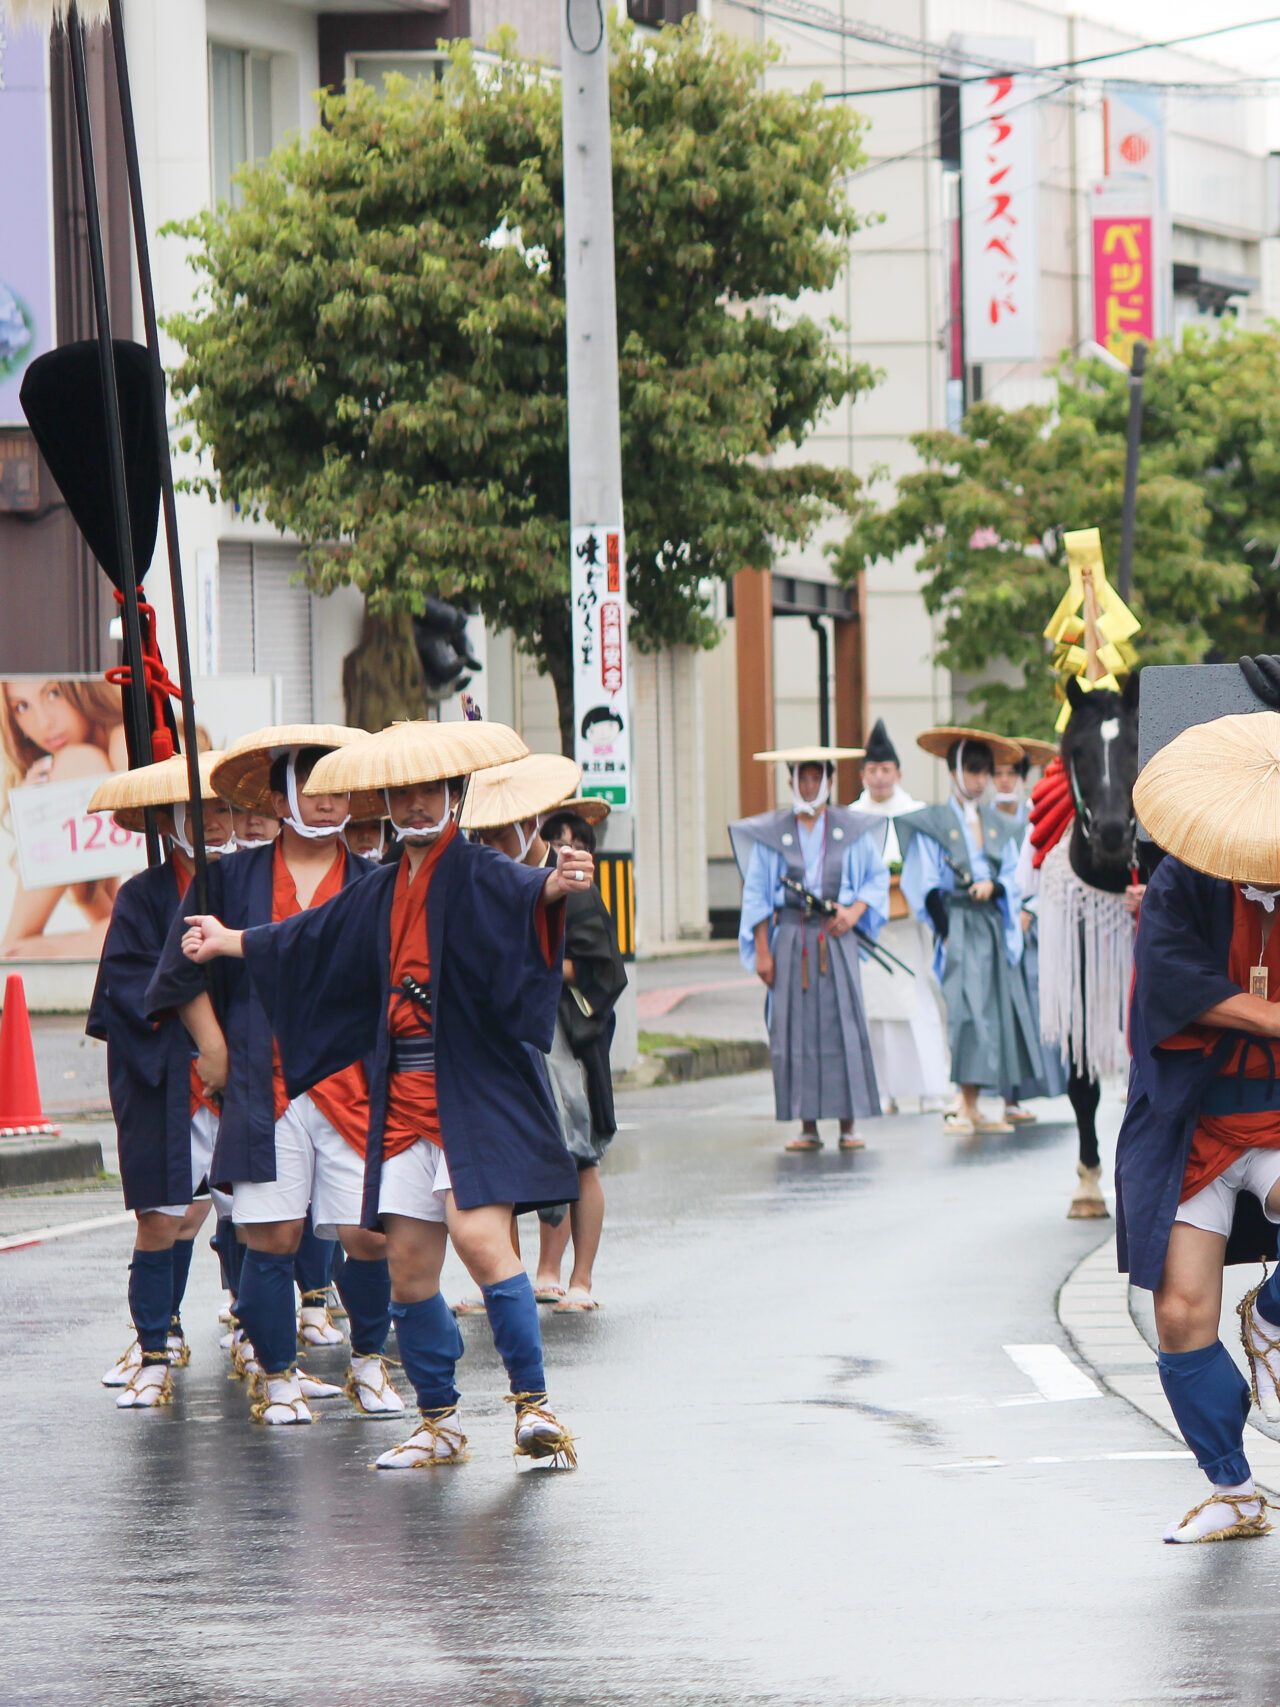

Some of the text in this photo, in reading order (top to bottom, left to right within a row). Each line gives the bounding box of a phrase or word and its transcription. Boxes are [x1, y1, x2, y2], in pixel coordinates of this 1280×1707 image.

[983, 75, 1018, 326] フランスベッド
